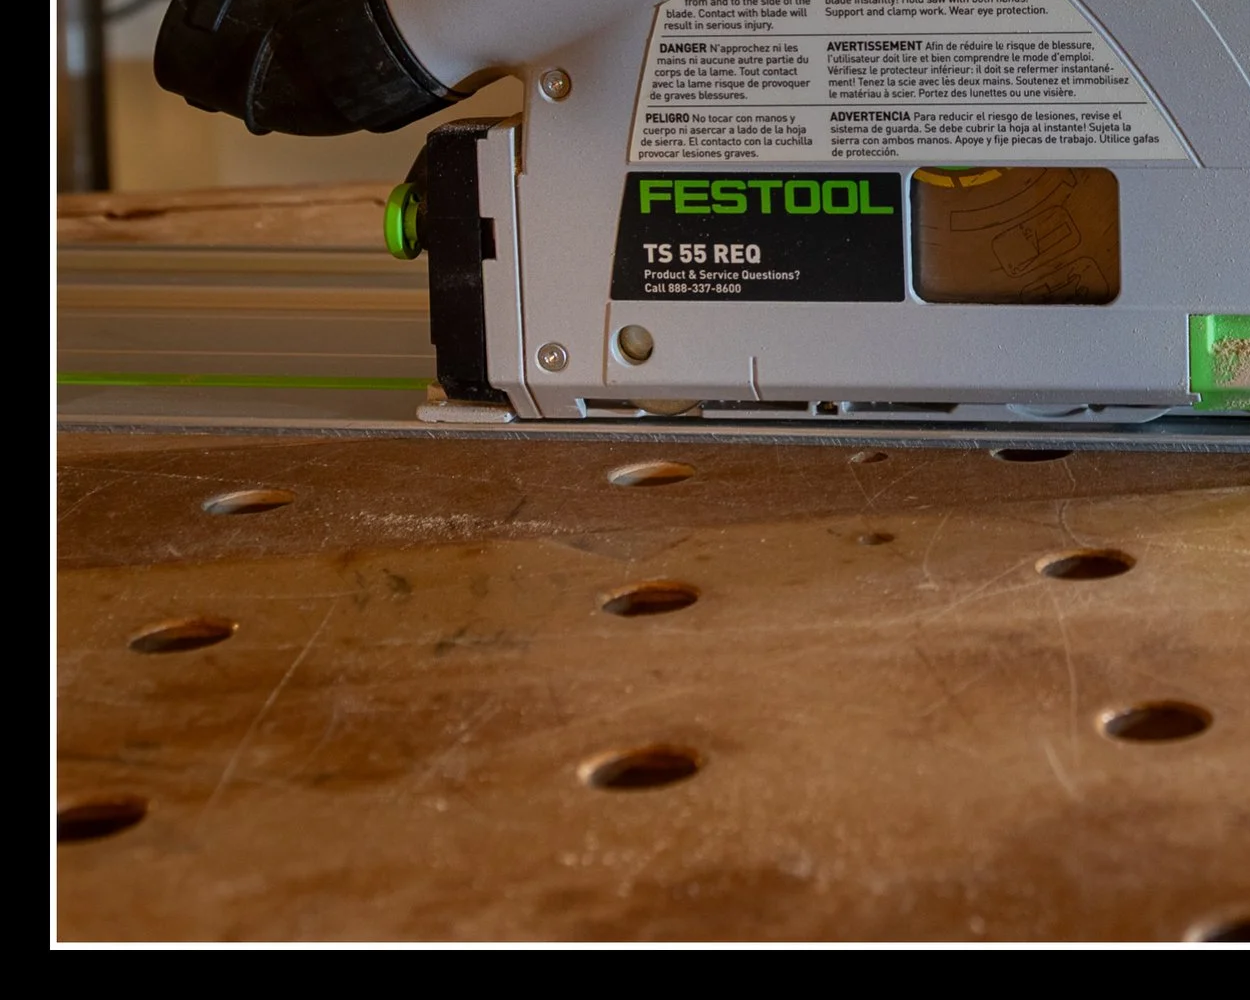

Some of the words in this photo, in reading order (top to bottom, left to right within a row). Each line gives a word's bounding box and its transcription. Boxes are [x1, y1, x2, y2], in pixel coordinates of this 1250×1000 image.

[666, 8, 696, 19] blade.
[698, 8, 736, 18] Contact
[737, 7, 759, 18] with
[761, 7, 788, 18] blade
[789, 7, 807, 17] will
[825, 6, 864, 19] Support
[867, 6, 884, 16] and
[887, 5, 917, 18] clamp
[919, 5, 946, 16] work.
[949, 5, 975, 16] Wear
[977, 7, 994, 17] eye
[996, 4, 1048, 17] protection.
[664, 20, 692, 30] result
[695, 20, 704, 30] in
[706, 19, 742, 30] serious
[744, 19, 774, 32] injury.
[659, 42, 707, 54] DANGER
[710, 42, 770, 55] N'approchez
[773, 42, 782, 52] ni
[784, 42, 798, 53] les
[827, 40, 923, 52] AVERTISSEMENT
[925, 40, 944, 51] Afin
[946, 41, 958, 51] de
[960, 39, 993, 51] réduire
[996, 40, 1004, 50] le
[1007, 40, 1036, 54] risque
[1038, 40, 1050, 50] de
[1052, 39, 1095, 53] blessure,
[657, 55, 686, 65] mains
[689, 55, 698, 65] ni
[700, 56, 736, 65] aucune
[738, 55, 764, 65] autre
[766, 54, 794, 66] partie
[797, 54, 809, 64] du
[827, 52, 880, 64] l'utilisateur
[883, 52, 900, 63] doit
[902, 52, 918, 63] lire
[920, 53, 929, 63] et
[931, 52, 951, 63] bien
[953, 52, 1010, 66] comprendre
[1012, 51, 1020, 62] le
[1023, 51, 1049, 62] mode
[1051, 51, 1094, 65] d'emploi.
[655, 69, 682, 80] corps
[684, 66, 696, 77] de
[698, 67, 708, 76] la
[709, 66, 736, 77] lame.
[739, 65, 760, 76] Tout
[762, 66, 798, 76] contact
[827, 64, 867, 75] Vérifiesz
[869, 65, 878, 75] le
[880, 65, 928, 78] protecteur
[931, 63, 974, 75] inférieur:
[976, 64, 982, 74] il
[984, 63, 1002, 74] doit
[1004, 66, 1015, 74] se
[1017, 62, 1059, 74] refermer
[1061, 62, 1114, 74] instantané-
[652, 80, 674, 89] avec
[676, 78, 686, 88] la
[688, 78, 712, 88] lame
[715, 78, 745, 90] risque
[747, 77, 759, 88] de
[762, 79, 811, 90] provoquer
[650, 89, 662, 100] de
[664, 92, 696, 103] graves
[698, 89, 748, 100] blessures.
[645, 112, 690, 124] PELIGRO
[692, 113, 706, 123] No
[708, 114, 734, 123] tocar
[735, 115, 753, 123] con
[755, 114, 788, 123] manos
[790, 115, 796, 124] y
[830, 110, 911, 122] ADVERTENCIA
[914, 111, 936, 122] Para
[939, 111, 974, 121] reducir
[976, 111, 986, 121] el
[988, 111, 1018, 124] riesgo
[1021, 110, 1032, 121] de
[1035, 110, 1078, 124] lesiones,
[1081, 110, 1110, 121] revise
[1112, 110, 1122, 120] el
[639, 150, 680, 160] provocar
[682, 147, 722, 158] lesiones
[724, 149, 758, 160] graves.
[832, 146, 844, 157] de
[846, 146, 899, 158] protección.
[640, 180, 894, 214] FESTOOL
[643, 244, 673, 264] TS
[680, 244, 707, 264] 55
[714, 244, 761, 264] REQ
[644, 270, 686, 280] Product
[688, 270, 697, 280] &
[699, 270, 739, 280] Service
[742, 270, 800, 281] Questions?
[645, 283, 666, 293] Call
[668, 283, 742, 293] 888-337-8600
